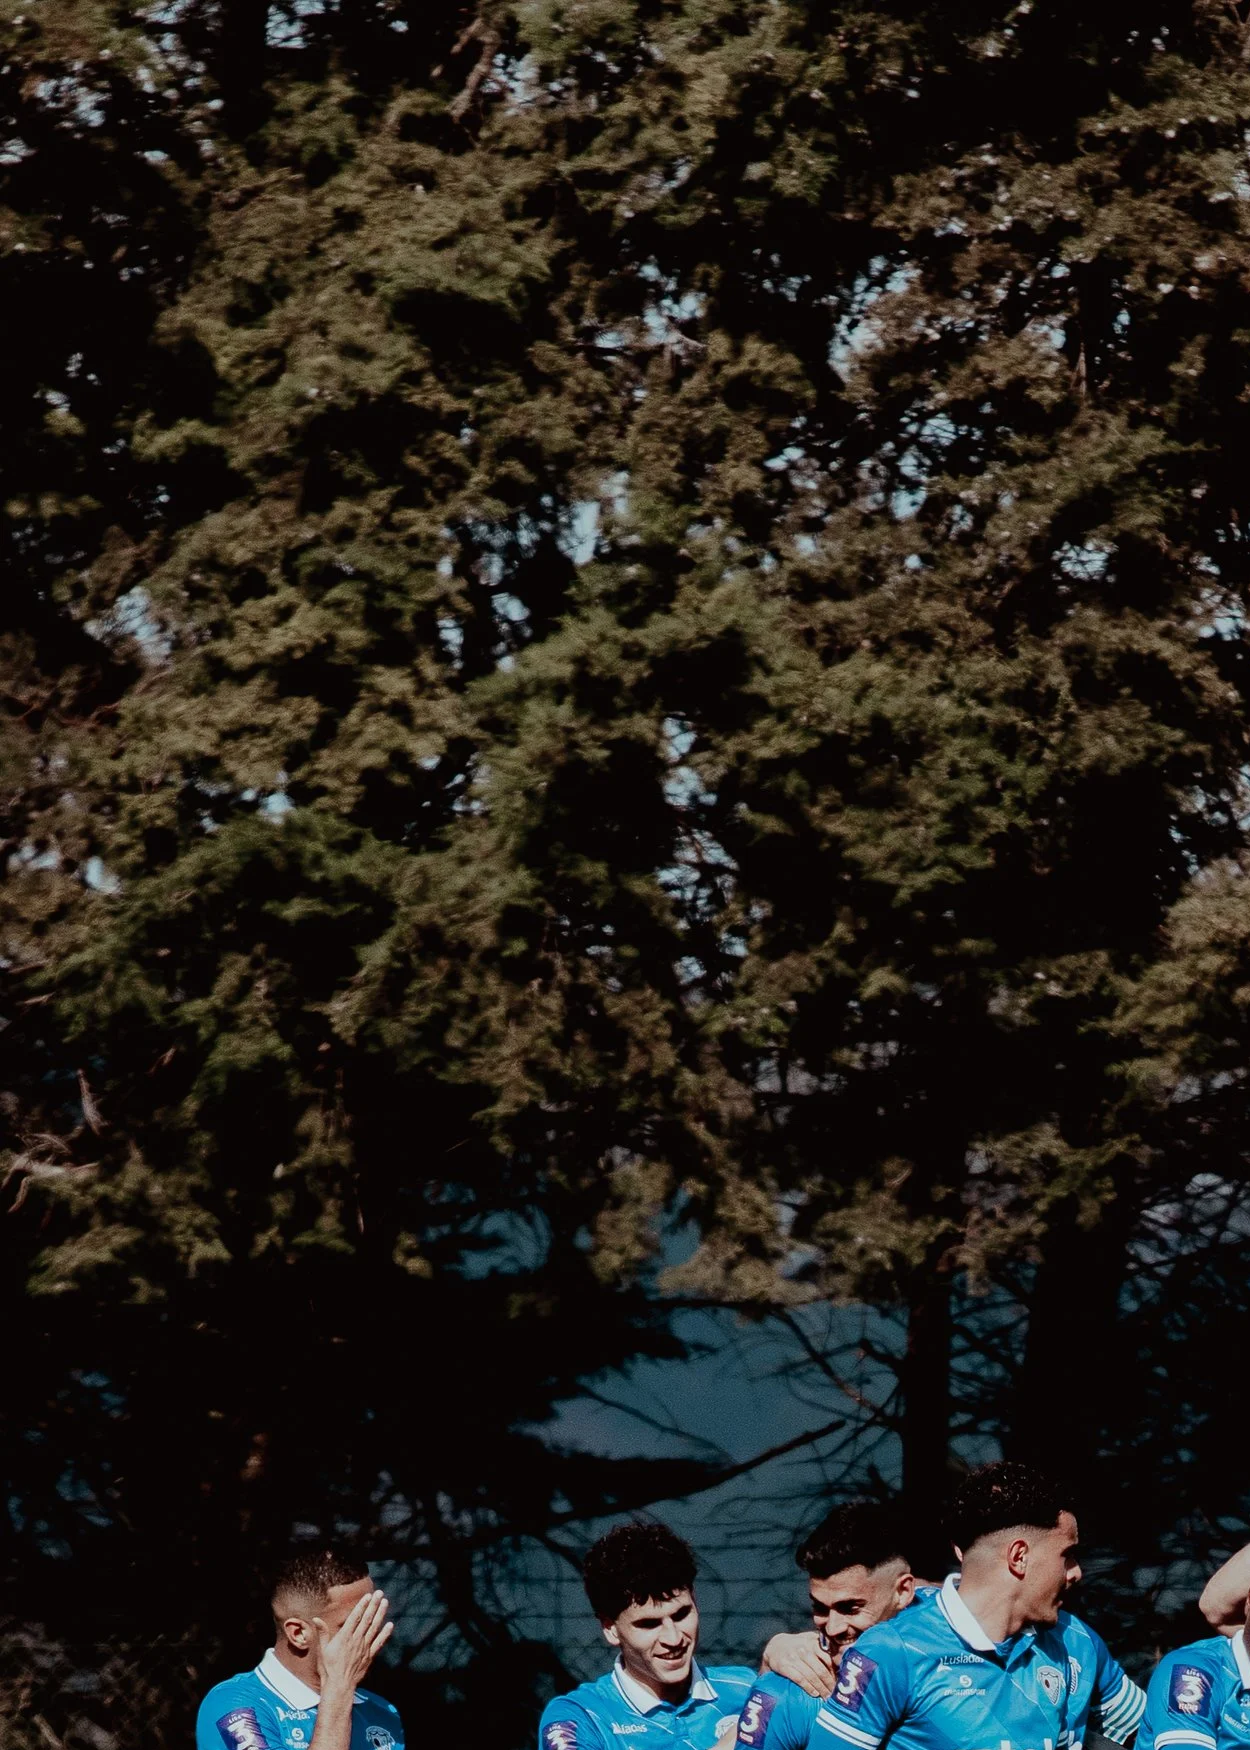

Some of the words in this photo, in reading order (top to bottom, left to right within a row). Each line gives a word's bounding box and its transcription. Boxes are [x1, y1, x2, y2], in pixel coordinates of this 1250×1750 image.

[838, 1661, 863, 1696] 3
[1176, 1674, 1203, 1703] 3
[740, 1701, 763, 1734] 3
[227, 1719, 256, 1750] 3
